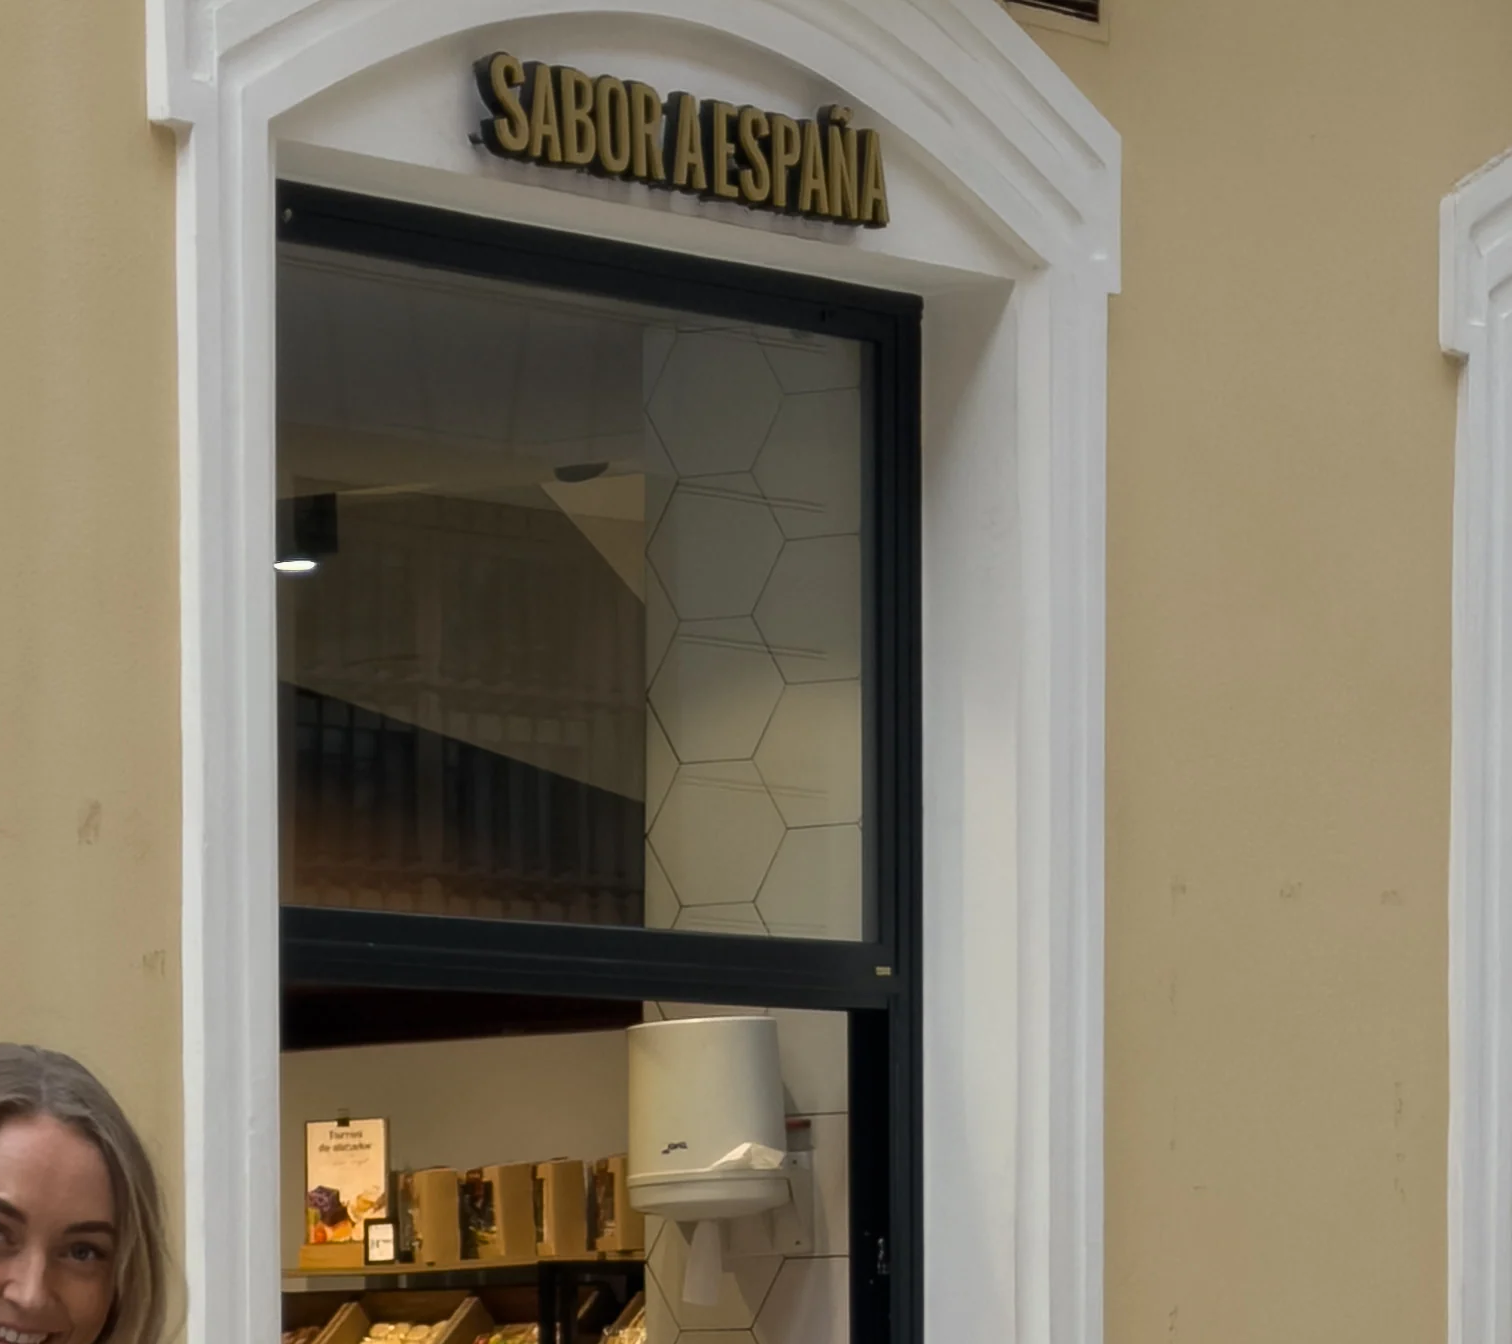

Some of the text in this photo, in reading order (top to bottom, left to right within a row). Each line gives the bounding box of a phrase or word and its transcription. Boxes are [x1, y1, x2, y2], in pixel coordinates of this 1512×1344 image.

[476, 52, 890, 228] SABOR A ESPAÑA
